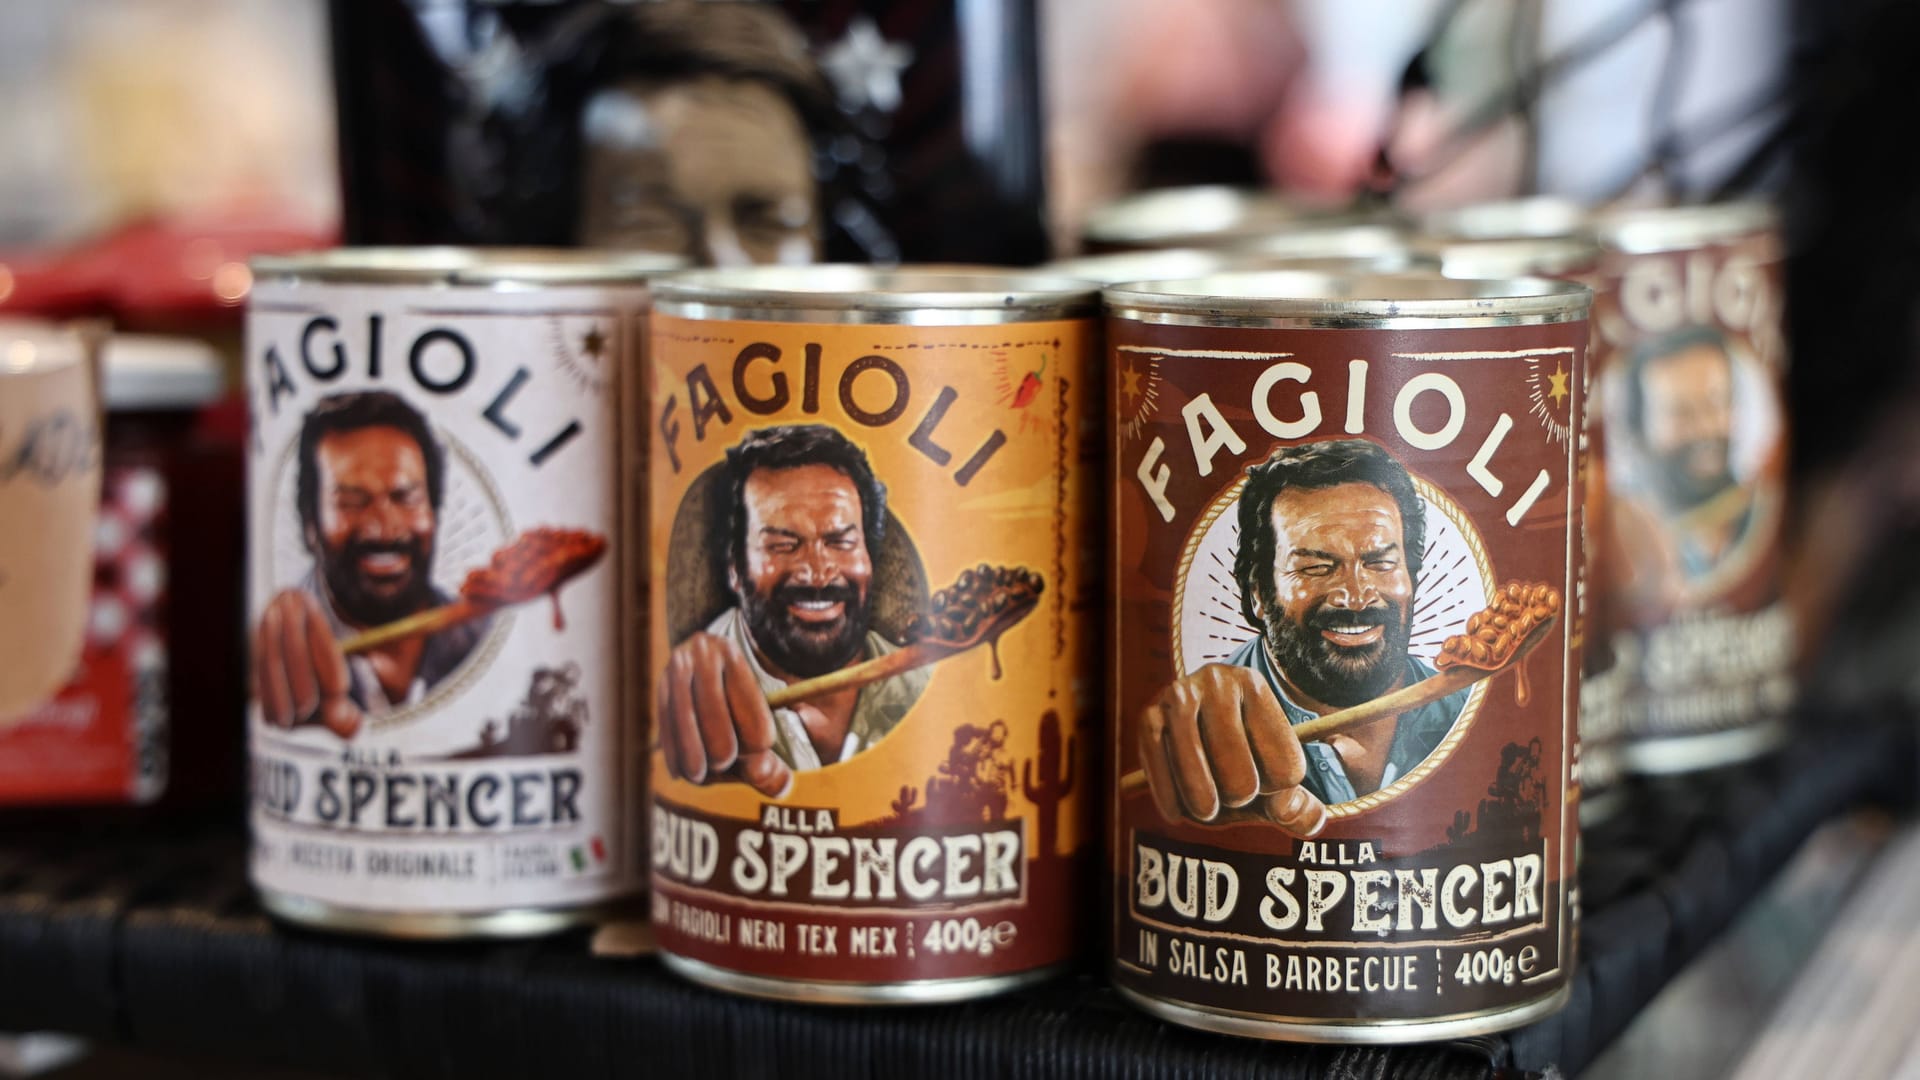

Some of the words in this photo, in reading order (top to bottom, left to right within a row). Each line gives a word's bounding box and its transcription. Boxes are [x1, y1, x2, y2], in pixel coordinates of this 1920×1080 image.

[251, 315, 583, 468] AGIOLI
[660, 342, 1007, 487] FAGIOLI
[1137, 360, 1550, 527] FAGIOLI
[315, 767, 582, 828] SPENCER
[763, 806, 835, 832] ALLA
[653, 804, 719, 882] BUD
[731, 829, 1020, 899] SPENCER
[1137, 844, 1240, 922] BUD
[1259, 853, 1542, 931] SPENCER
[1298, 841, 1377, 864] ALLA
[739, 917, 785, 951] NERI
[797, 923, 838, 955] TEX
[850, 925, 897, 957] MEX
[1139, 929, 1158, 966] IN
[1169, 939, 1249, 986] SALSA
[1266, 952, 1418, 992] BARBECUE
